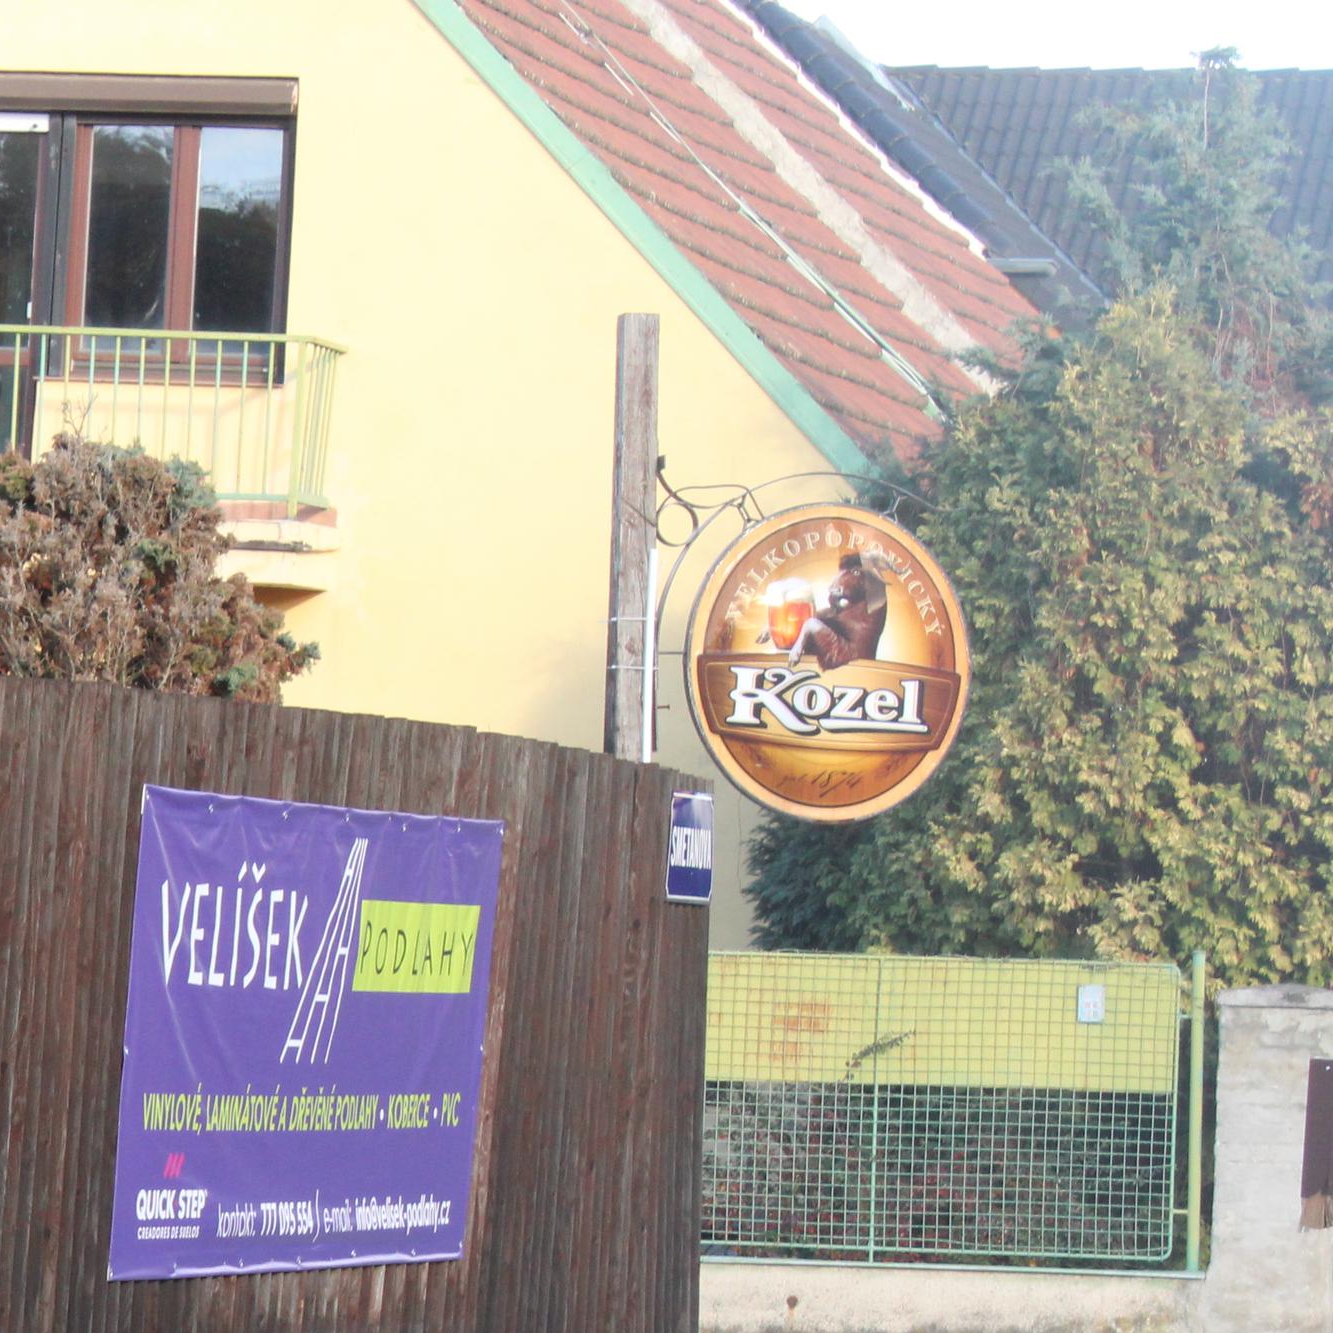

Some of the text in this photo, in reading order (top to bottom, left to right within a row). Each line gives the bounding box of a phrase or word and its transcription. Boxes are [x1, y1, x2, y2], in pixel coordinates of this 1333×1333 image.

[725, 665, 928, 735] Kozel
[670, 826, 711, 870] SMETANOVA
[160, 861, 309, 991] VELÍŠEK
[360, 918, 475, 978] PODLAHY
[143, 1082, 461, 1136] VINYLOVÉ, LAMINÁTOVÉ A DŘEVĚNÉ PODLAHY KOBERCE PVC
[136, 1189, 206, 1221] QUICK STEP
[216, 1203, 257, 1238] kontakt:
[260, 1202, 277, 1236] 777
[278, 1201, 296, 1236] 095
[296, 1200, 314, 1235] 554
[323, 1198, 353, 1234] e-mail:
[137, 1226, 170, 1241] CREADORES
[179, 1225, 200, 1239] SUELOS
